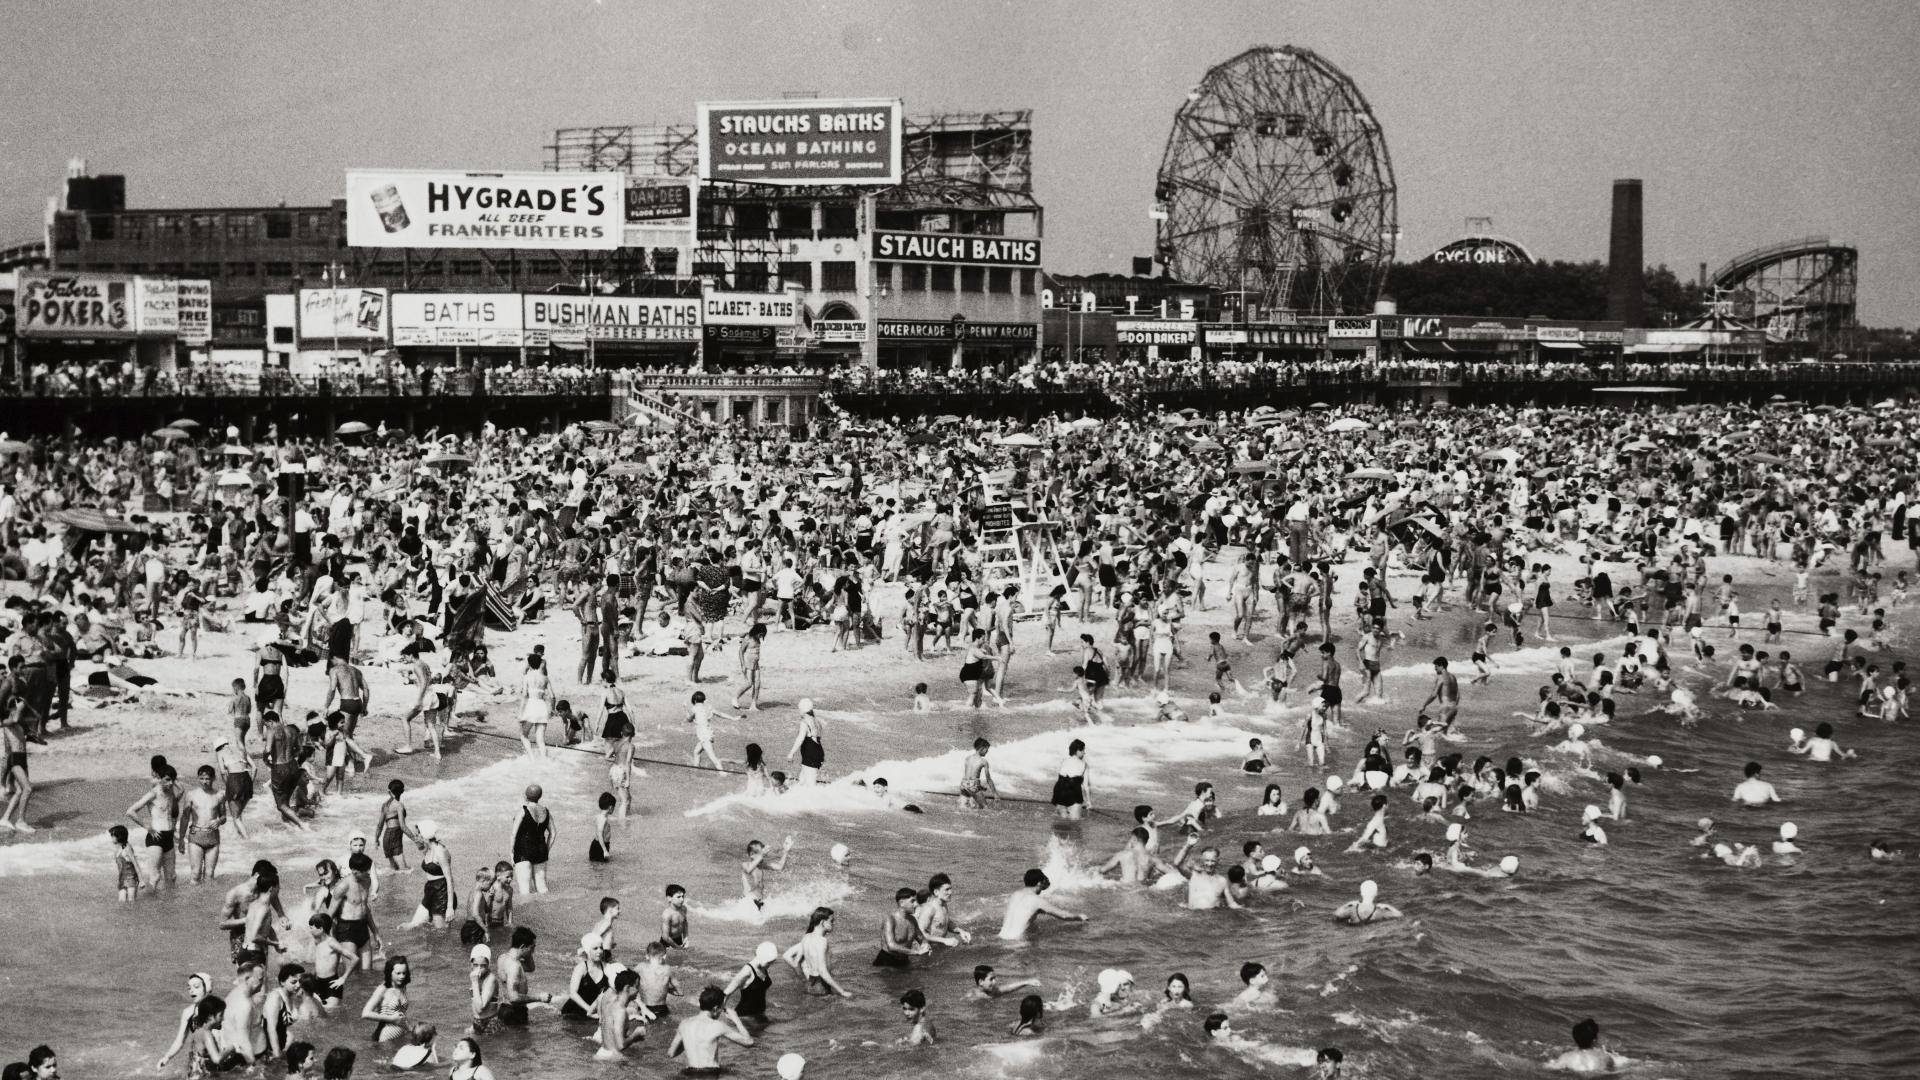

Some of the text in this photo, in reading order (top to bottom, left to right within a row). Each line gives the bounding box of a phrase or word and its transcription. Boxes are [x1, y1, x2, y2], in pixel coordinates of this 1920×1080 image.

[720, 113, 885, 134] STAUCHS BATHS
[725, 140, 877, 155] OCEAN BATHING
[794, 160, 840, 169] PARLORS
[428, 182, 605, 216] HYGRADE'S
[478, 214, 546, 222] ALL BEEF
[429, 224, 604, 238] FRANKFURTERS
[880, 235, 1036, 262] STAUCH BATHS
[1435, 250, 1506, 263] CYCLONE
[178, 298, 208, 308] BATHS
[708, 301, 793, 317] CLARET BATHS
[28, 299, 104, 325] POKER
[179, 311, 207, 320] FREE
[424, 302, 495, 321] BATHS
[535, 302, 697, 325] BUSHMAN BATHS
[1336, 320, 1370, 329] COOKS
[655, 329, 694, 338] POKER
[970, 327, 1033, 338] PENNY ARCADE
[1128, 332, 1187, 344] DON BAKER
